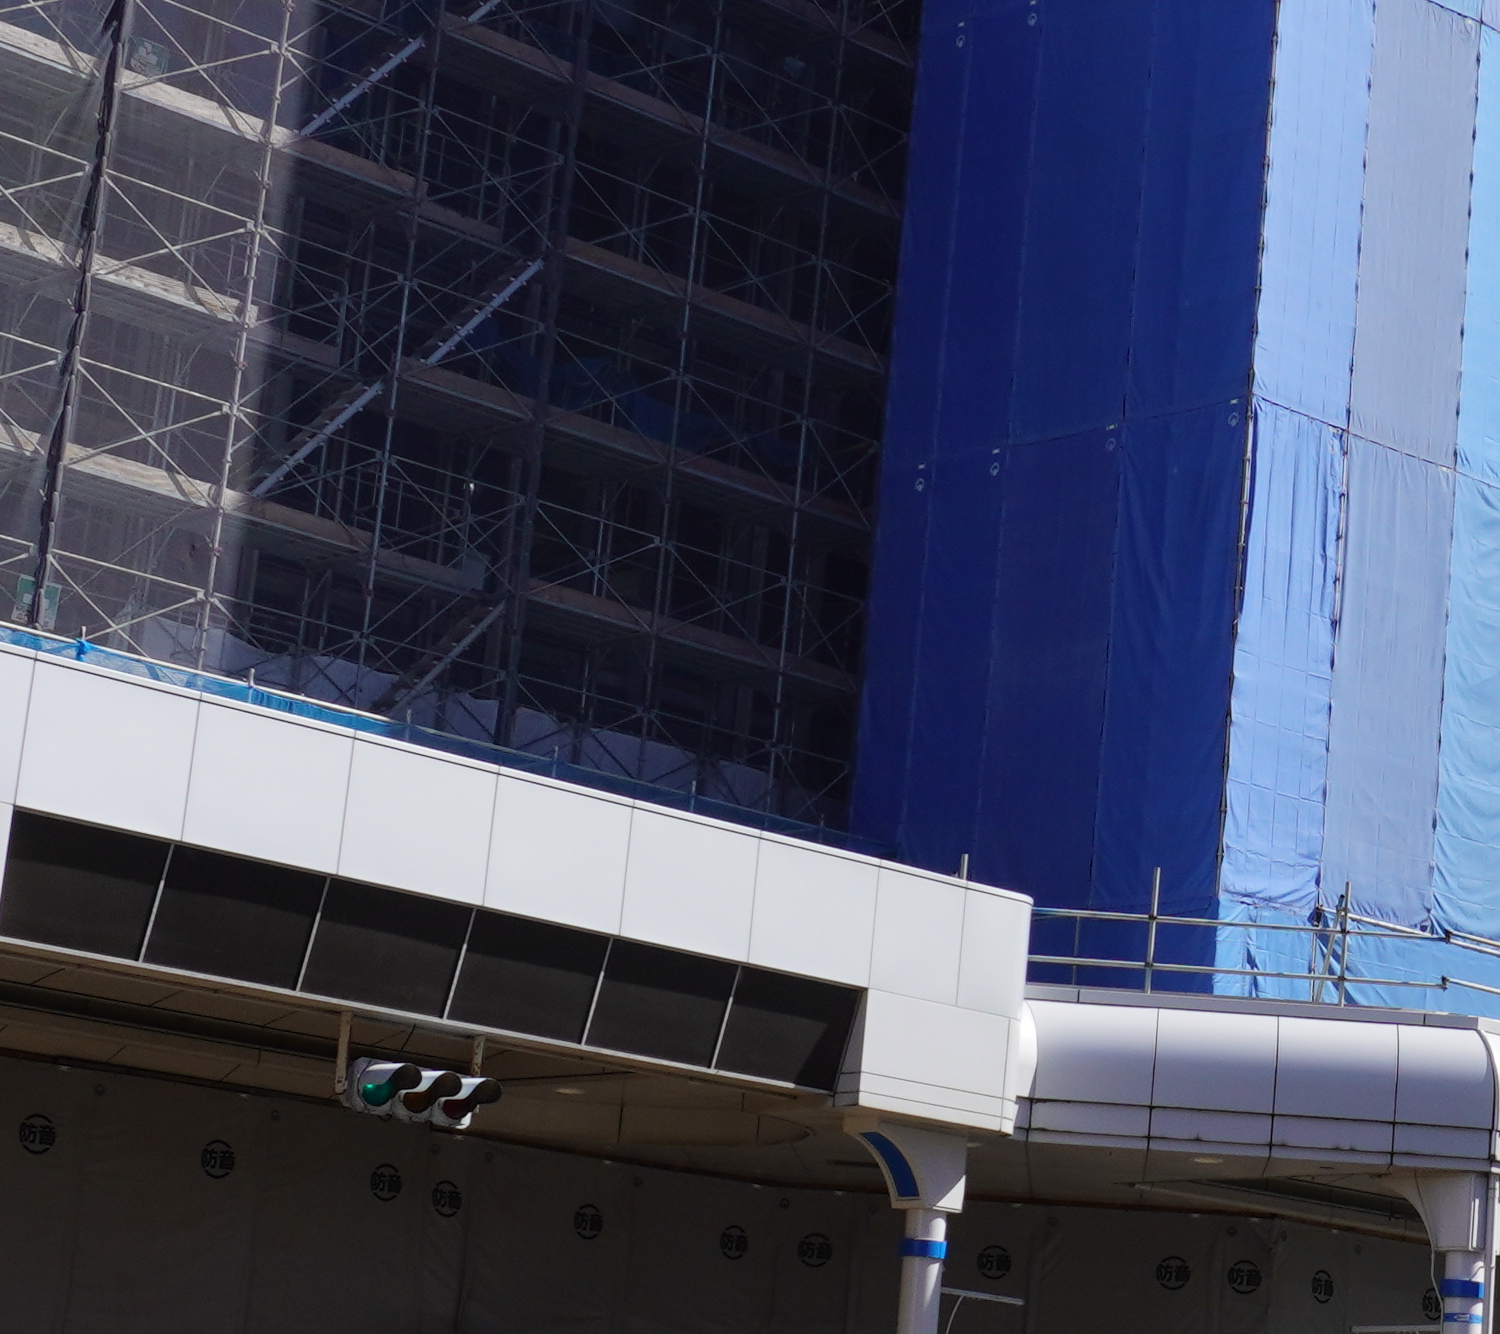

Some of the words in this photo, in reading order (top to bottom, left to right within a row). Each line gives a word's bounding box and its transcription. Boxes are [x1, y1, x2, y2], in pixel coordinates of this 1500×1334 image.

[19, 1124, 57, 1147] 防音
[201, 1148, 236, 1171] 防音
[370, 1171, 402, 1194] 防音
[432, 1188, 462, 1210] 防音
[573, 1212, 603, 1234] 防音
[719, 1232, 748, 1254] 防音
[797, 1240, 834, 1262] 防音
[977, 1251, 1012, 1274] 防音
